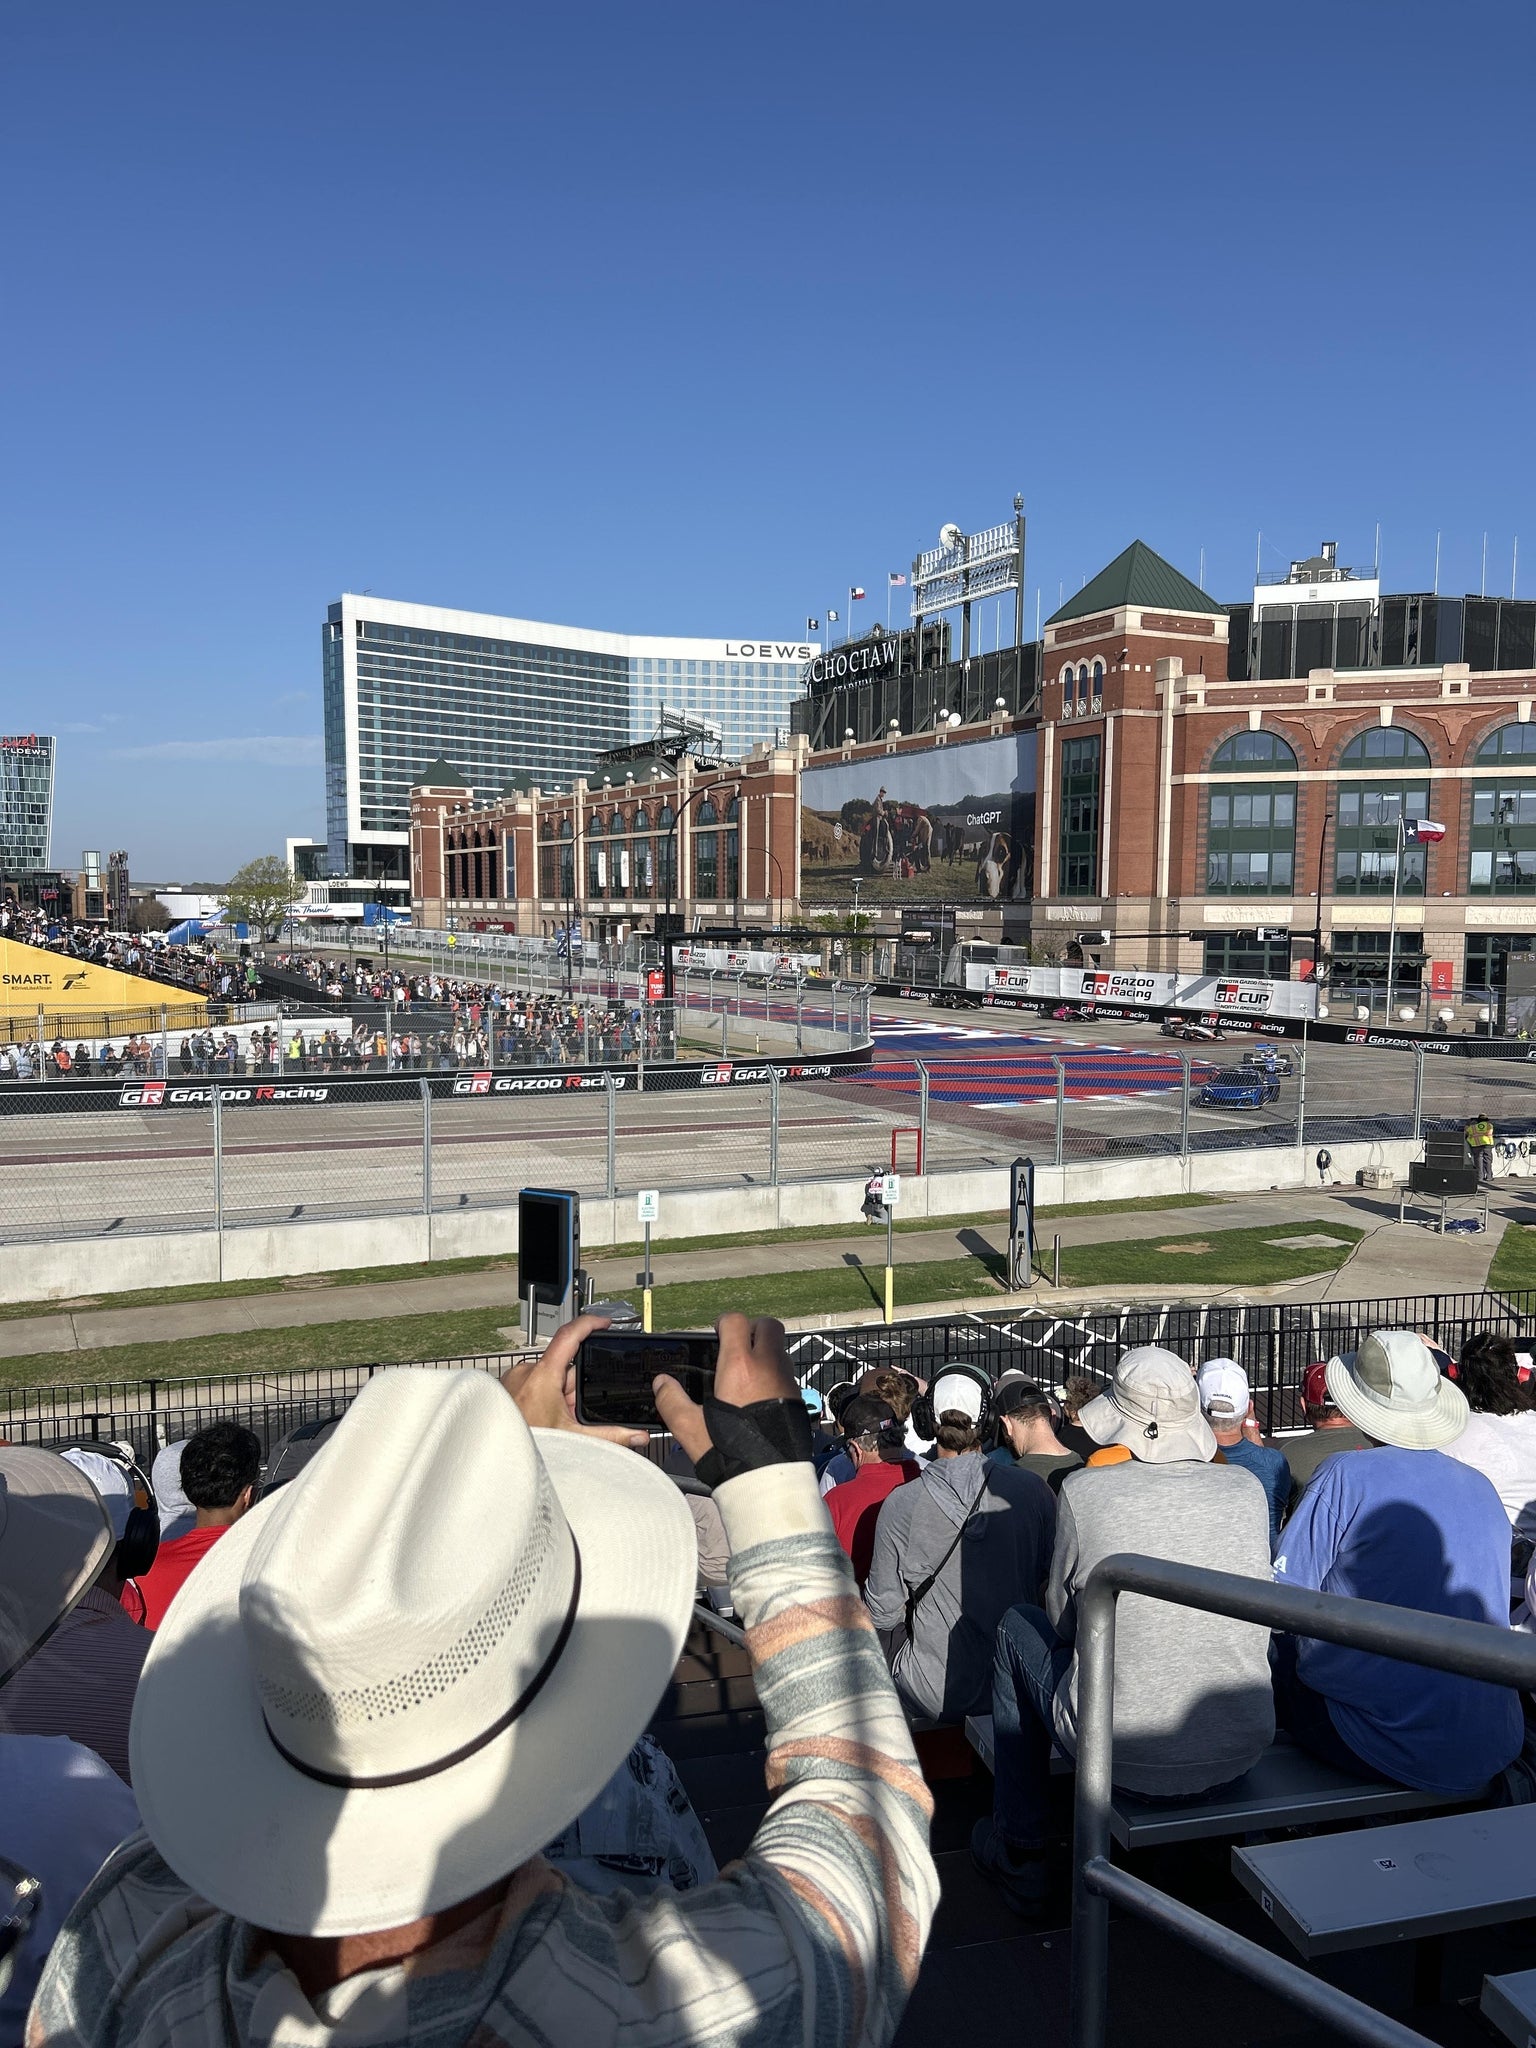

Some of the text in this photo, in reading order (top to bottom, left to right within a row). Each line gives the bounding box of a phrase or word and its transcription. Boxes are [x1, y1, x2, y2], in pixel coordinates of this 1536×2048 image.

[726, 643, 811, 659] LOEWS
[811, 639, 898, 683] CHOCTAW
[11, 748, 48, 756] LOEWS
[966, 811, 1002, 826] ChatGPT
[301, 904, 333, 914] Thumb
[2, 974, 53, 985] SMART.
[1008, 976, 1029, 987] CUP
[1081, 976, 1155, 995] GR GAZOO
[1109, 986, 1152, 1001] Racing
[1215, 990, 1270, 1004] GR CUP
[994, 998, 1017, 1007] GAZOO
[1017, 1000, 1039, 1011] Racing
[1095, 1007, 1123, 1017] GAZOO
[1124, 1010, 1150, 1021] Racing
[1200, 1016, 1286, 1034] GR GAZOO Racing
[1346, 1033, 1366, 1043] GR
[702, 1070, 731, 1082] GR
[790, 1066, 831, 1077] Racing
[455, 1079, 489, 1092] GR
[495, 1078, 562, 1091] GAZOO
[122, 1086, 328, 1104] GR GAZOO Racing
[1379, 1859, 1397, 1869] 25
[1263, 1896, 1272, 1912] 13
